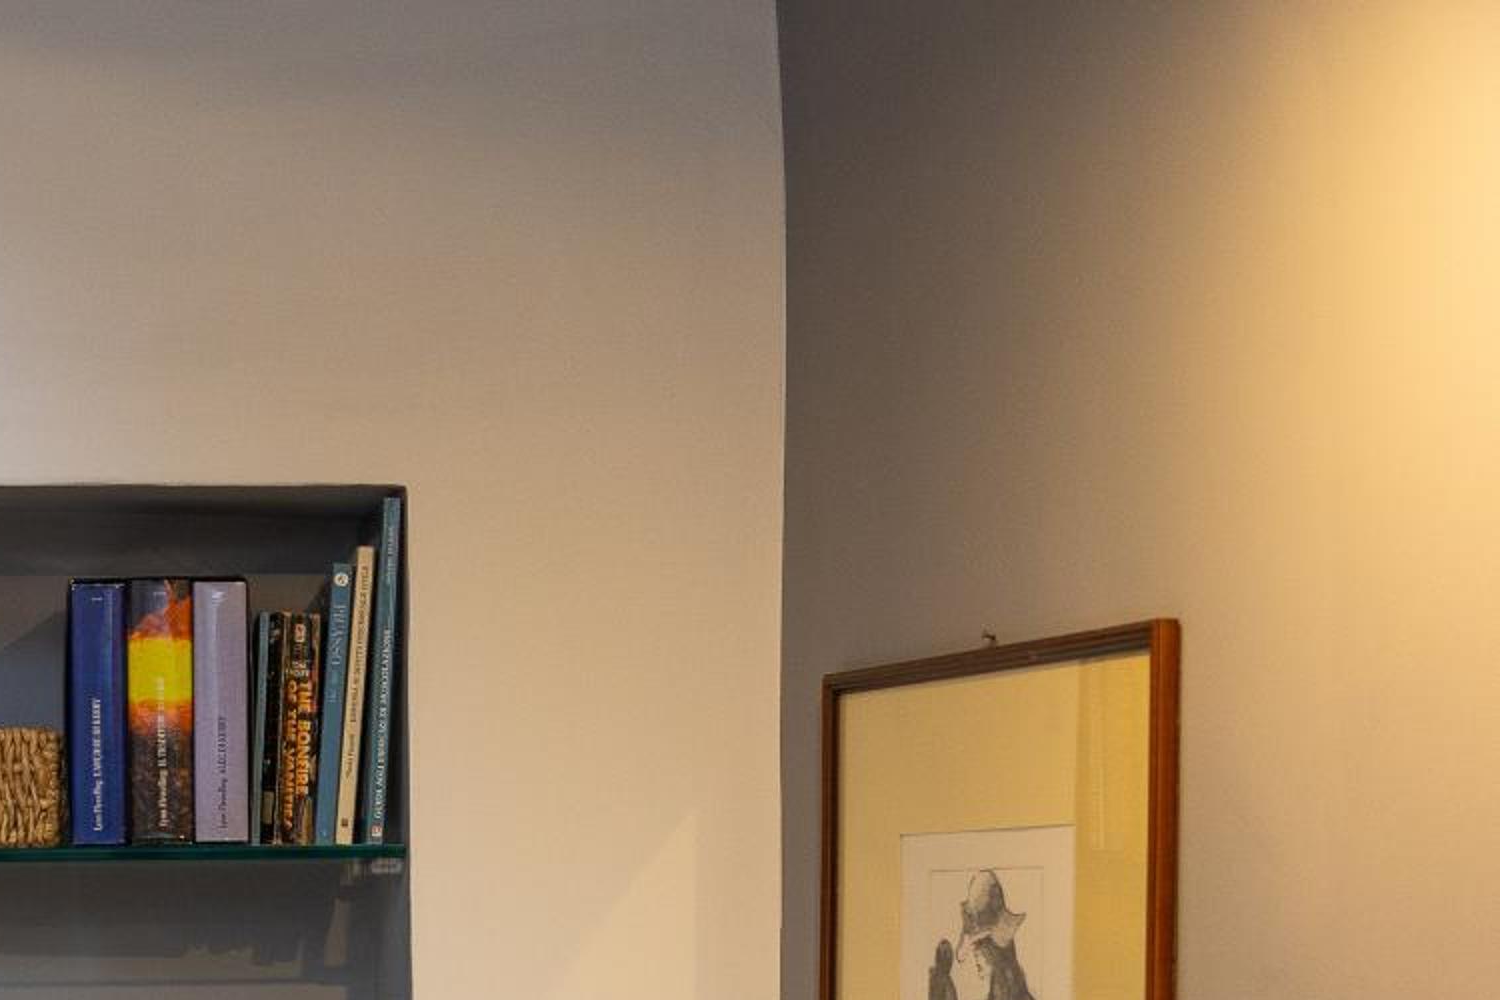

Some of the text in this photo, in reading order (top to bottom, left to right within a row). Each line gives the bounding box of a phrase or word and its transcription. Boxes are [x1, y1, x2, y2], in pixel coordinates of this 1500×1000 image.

[287, 680, 297, 701] OF
[298, 682, 311, 712] THE
[285, 708, 296, 741] THE
[296, 720, 311, 796] BONFIRE
